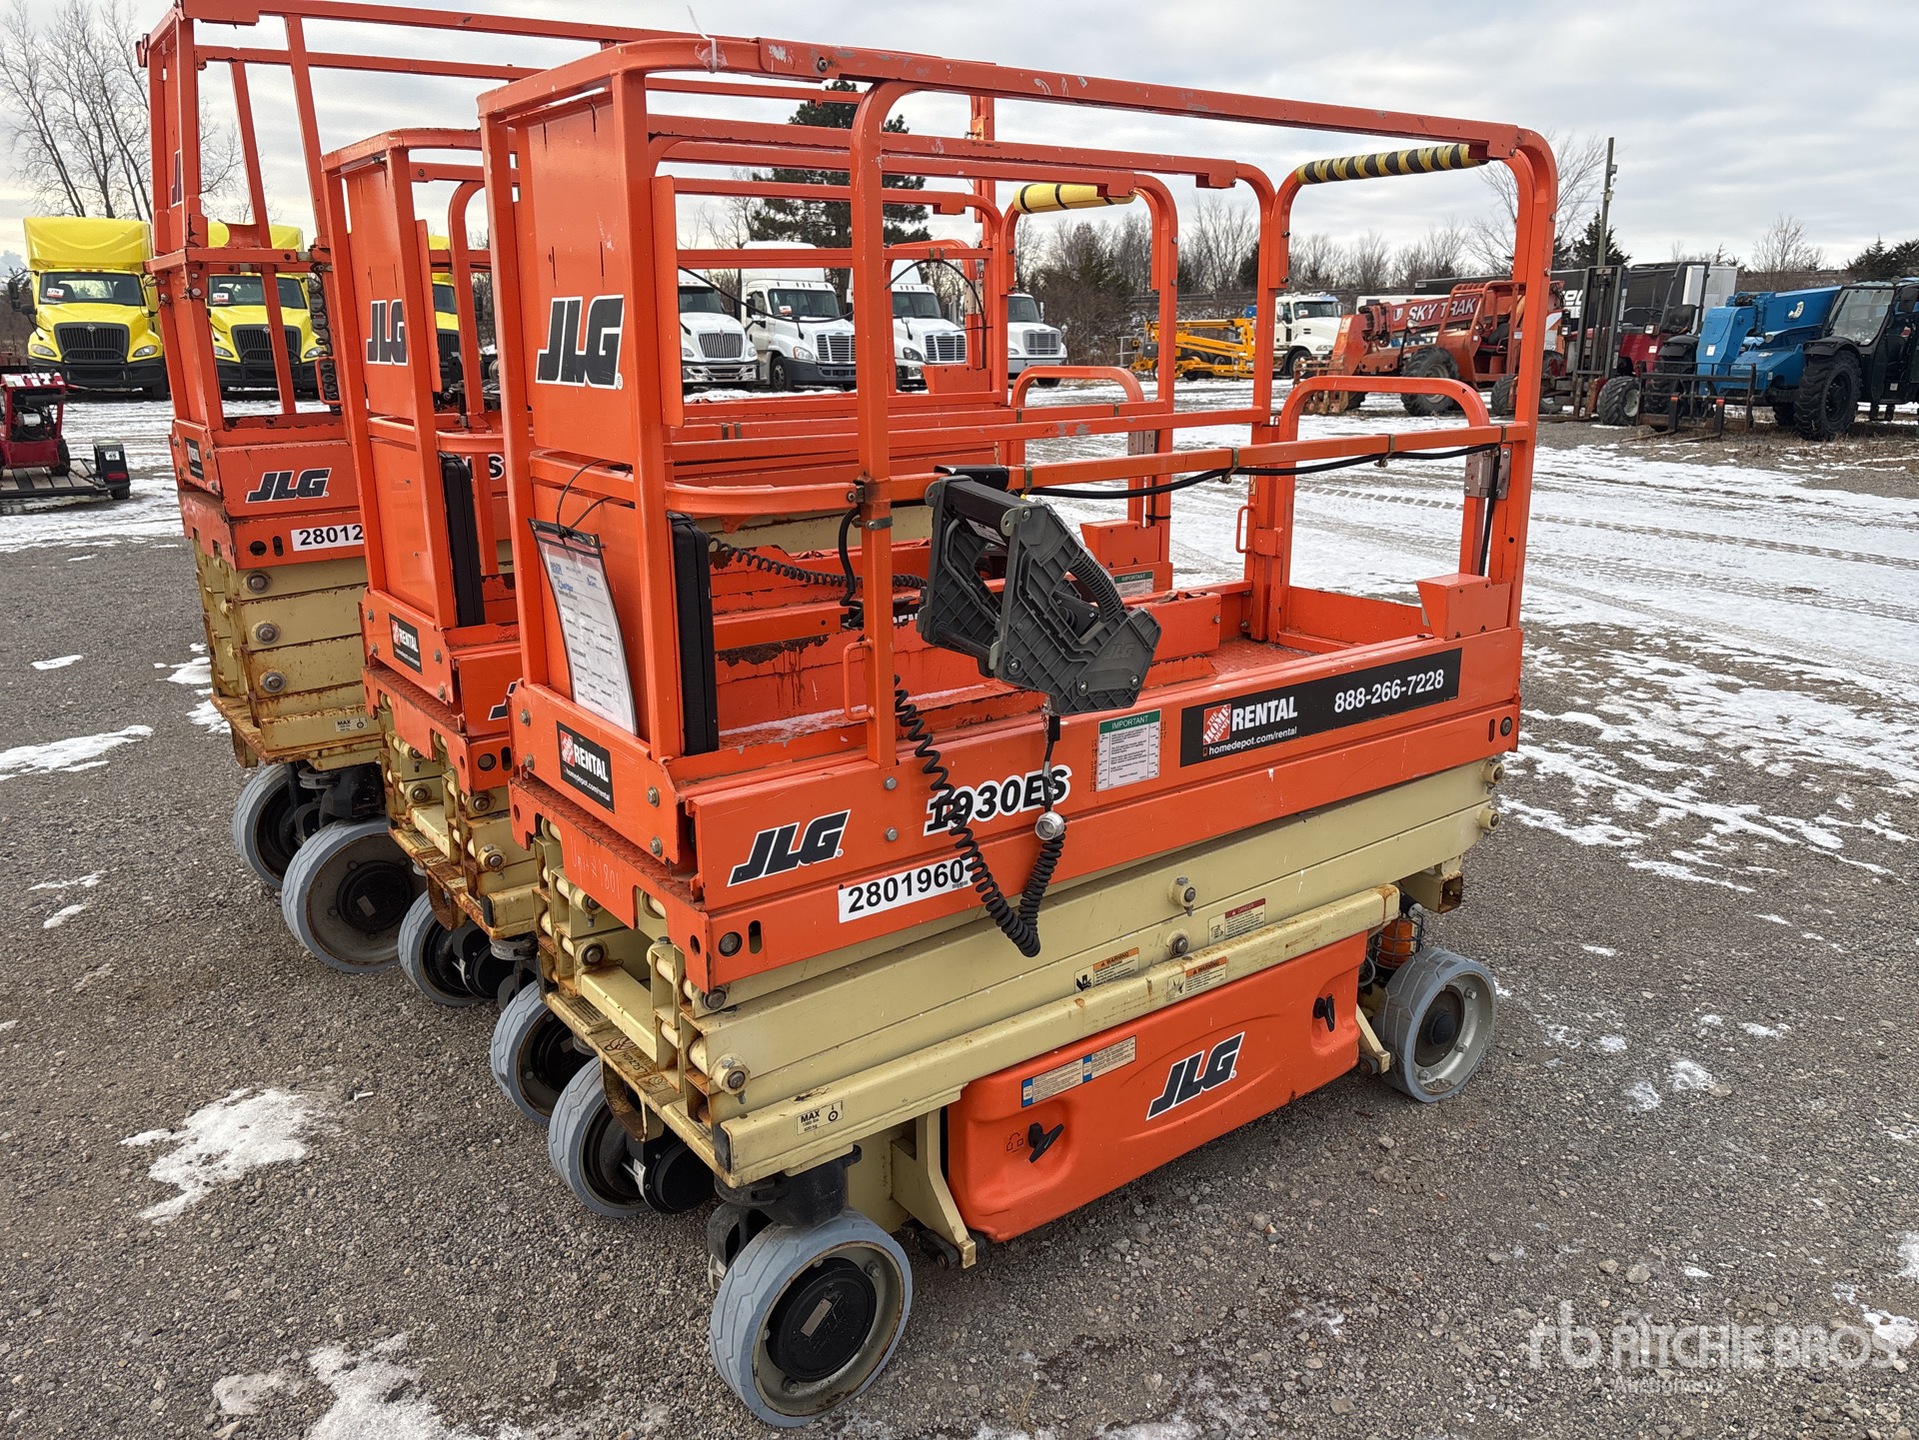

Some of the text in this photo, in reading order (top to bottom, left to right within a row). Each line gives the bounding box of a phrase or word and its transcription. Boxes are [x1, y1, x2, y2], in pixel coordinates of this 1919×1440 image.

[1406, 298, 1477, 321] SKY TRAK
[367, 299, 408, 365] JLG
[535, 294, 624, 389] JLG
[245, 467, 332, 503] JLG
[1334, 669, 1444, 713] 888-266-7228
[1111, 715, 1149, 730] IMPORTANT
[1203, 704, 1231, 744] HOME
[1231, 696, 1298, 732] RENTAL
[1208, 726, 1298, 756] homedepot.com/rental
[573, 743, 609, 783] RENTAL
[926, 768, 1069, 832] 1930ES
[728, 810, 851, 887] JLG
[848, 858, 964, 914] 2801960
[1146, 1032, 1245, 1121] JLG
[800, 1109, 820, 1124] MAX
